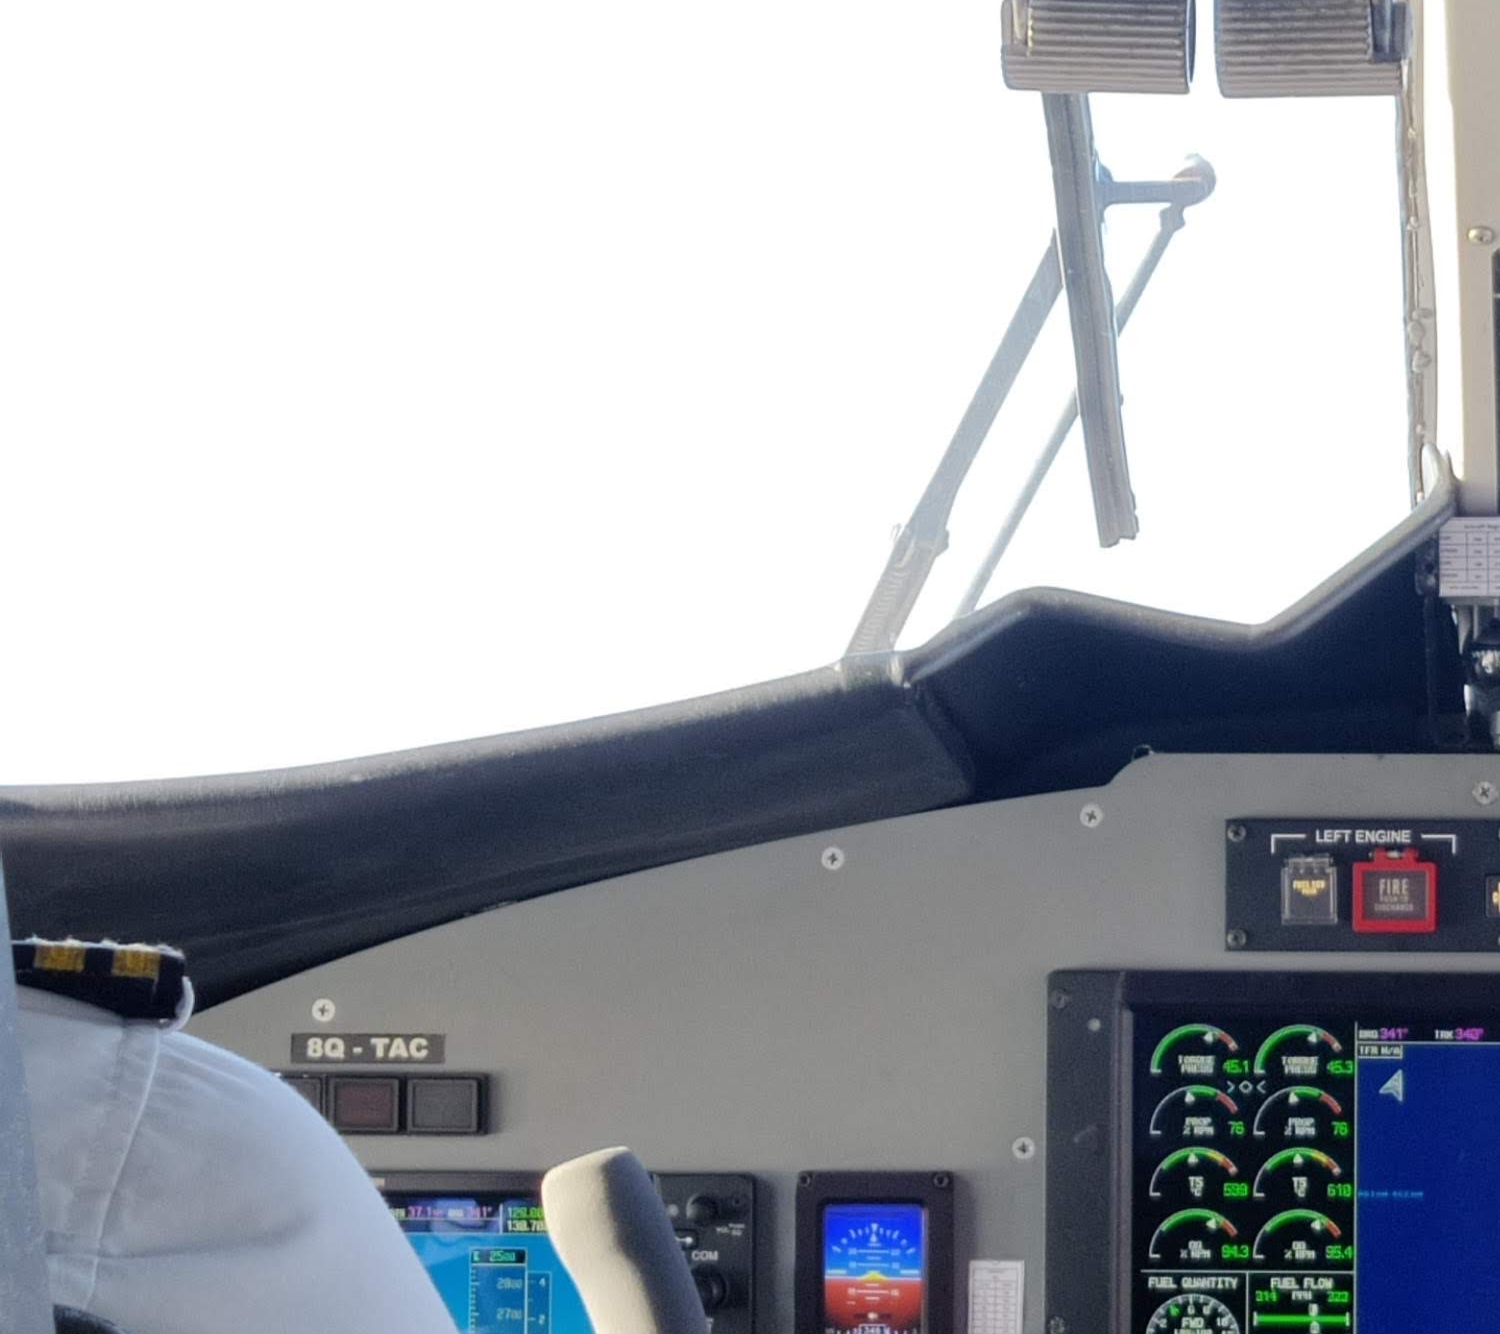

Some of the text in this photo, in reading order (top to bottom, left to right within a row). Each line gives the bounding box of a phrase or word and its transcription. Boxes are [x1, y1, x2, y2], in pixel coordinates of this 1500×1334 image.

[1314, 829, 1412, 844] LEFT ENGINE
[1378, 878, 1410, 896] FIRE
[306, 1036, 344, 1060] 8Q
[370, 1036, 429, 1059] TAC
[691, 1250, 719, 1261] COM
[1147, 1276, 1238, 1289] FUEL QUANTITY
[1270, 1276, 1334, 1289] FUEL FLOW
